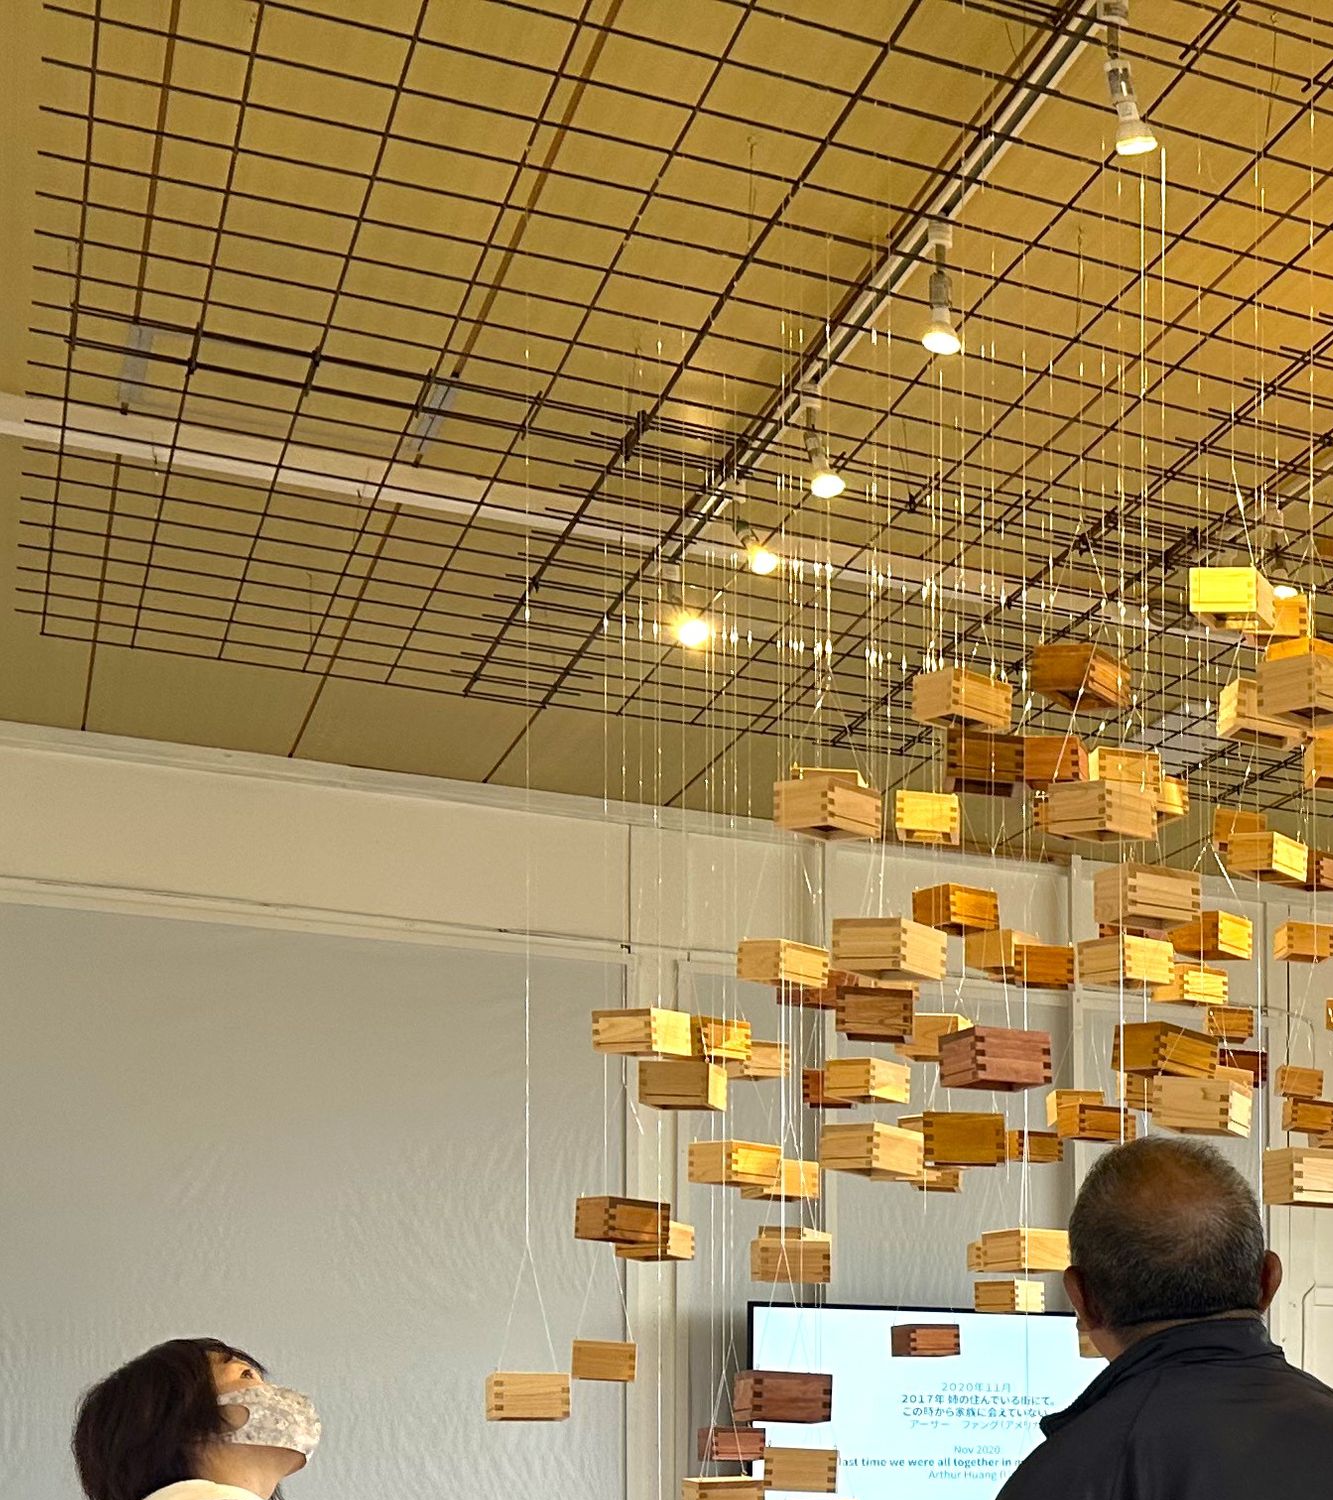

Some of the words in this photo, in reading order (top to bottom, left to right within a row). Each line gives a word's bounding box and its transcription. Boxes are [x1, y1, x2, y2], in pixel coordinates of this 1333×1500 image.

[941, 1382, 1011, 1393] 2020年11月
[901, 1394, 945, 1405] 2017年
[954, 1445, 975, 1455] Nov
[976, 1445, 1002, 1455] 2020
[838, 1456, 859, 1467] last
[861, 1456, 888, 1467] time
[889, 1458, 905, 1467] we
[907, 1458, 935, 1467] were
[937, 1457, 951, 1467] all
[953, 1457, 999, 1469] together
[1001, 1457, 1012, 1467] in
[928, 1469, 962, 1480] Arthur
[964, 1470, 998, 1482] Huang
